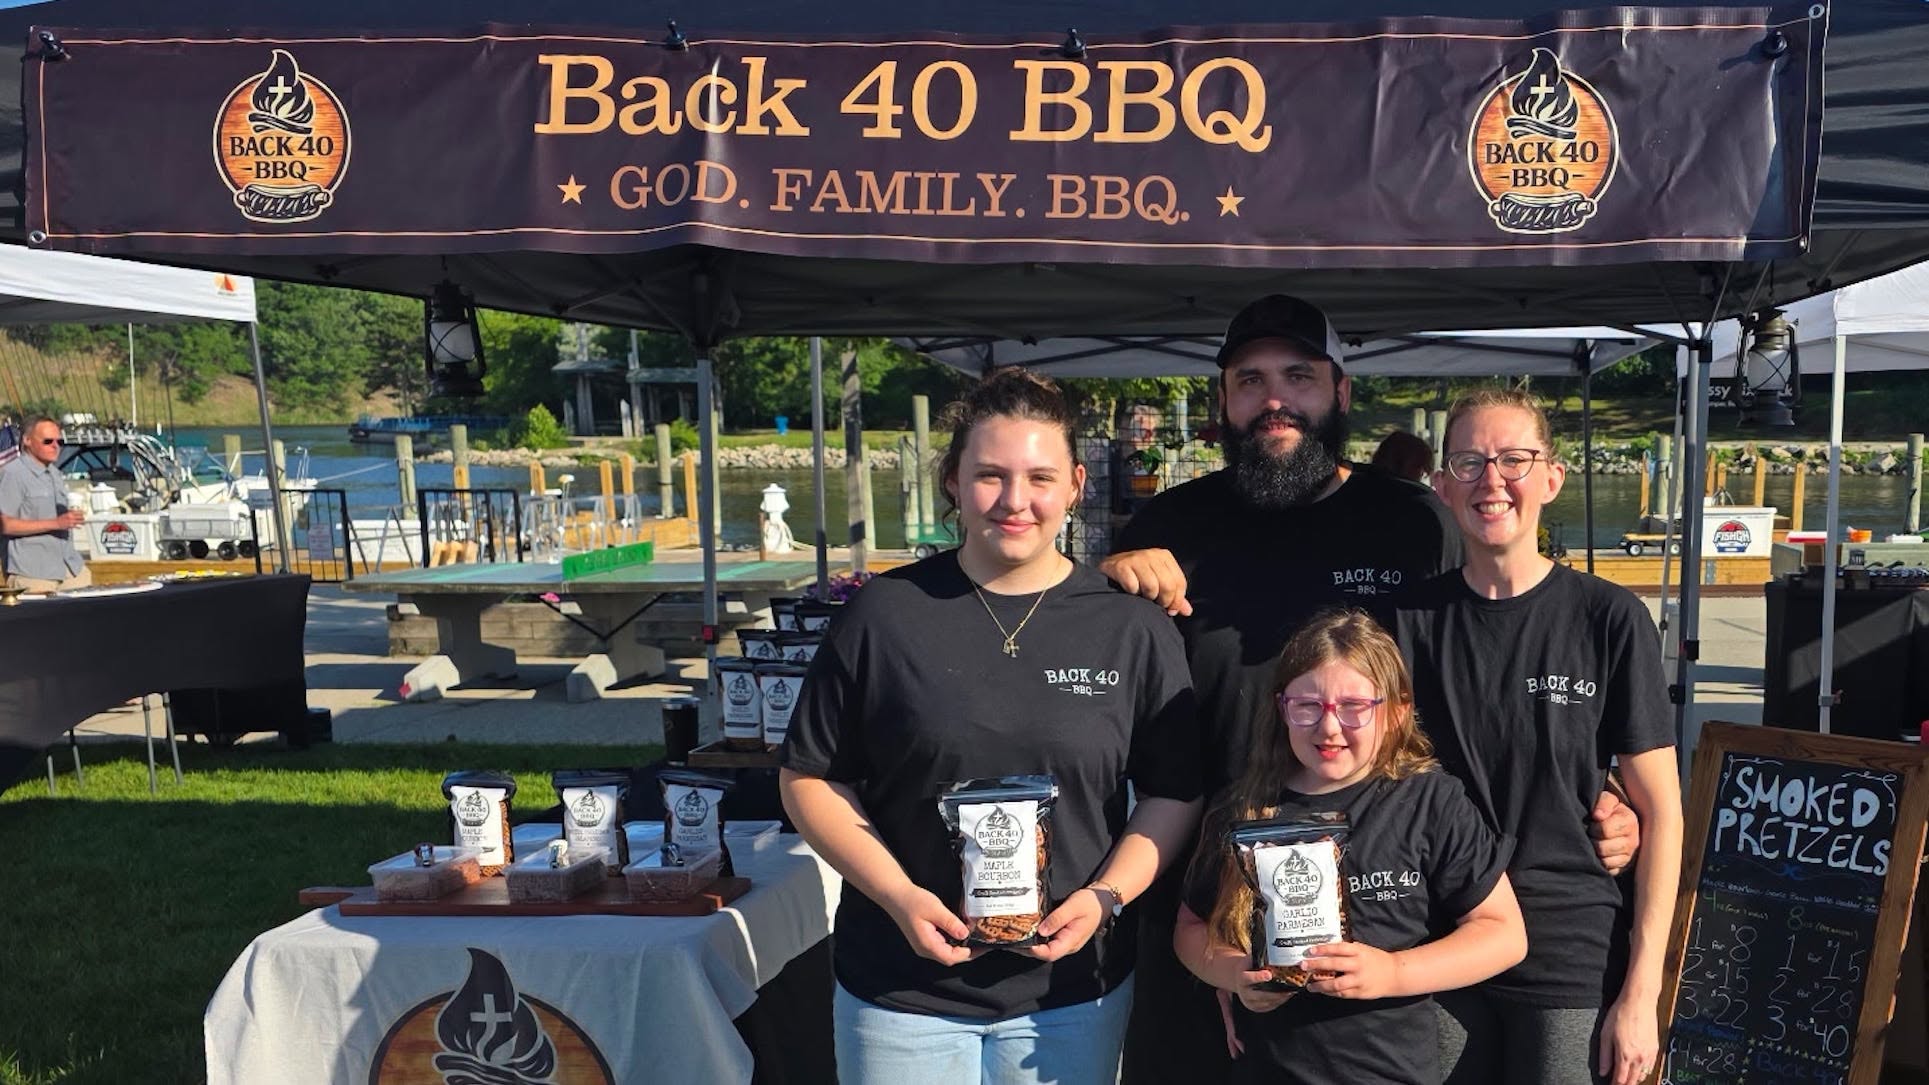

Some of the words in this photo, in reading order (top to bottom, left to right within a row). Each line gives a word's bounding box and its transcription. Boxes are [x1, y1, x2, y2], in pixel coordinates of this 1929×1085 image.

[534, 53, 810, 137] Back
[840, 60, 979, 140] 40
[1009, 56, 1272, 153] BBQ
[229, 136, 294, 158] BACK
[297, 135, 334, 157] 40
[1485, 141, 1557, 165] BACK
[1559, 139, 1600, 164] 40
[255, 160, 308, 182] BBQ
[1512, 167, 1572, 190] BBQ
[610, 160, 750, 210] GOD.
[770, 168, 1026, 219] FAMILY.
[1045, 173, 1191, 225] BBQ.
[1332, 568, 1375, 585] BACK
[1380, 569, 1402, 585] 40
[1357, 585, 1376, 595] BBQ
[1044, 668, 1091, 684] BACK
[1095, 669, 1120, 686] 40
[1526, 675, 1570, 693] BACK
[1573, 679, 1597, 697] 40
[1072, 685, 1093, 696] BBQ
[1550, 692, 1569, 705] BBQ
[1732, 766, 1880, 828] SMOKED
[978, 831, 1004, 839] BACK
[988, 838, 1010, 846] BBQ
[1714, 808, 1892, 877] PRETZELS
[978, 870, 1021, 881] BOURBON
[983, 860, 1015, 870] MAPLE
[1276, 877, 1302, 889] BACK
[1304, 875, 1318, 883] 40
[1348, 870, 1395, 893] BACK
[1399, 870, 1420, 886] 40
[1376, 890, 1397, 901] BBQ
[1277, 918, 1326, 931] PARMESAN
[1689, 917, 1706, 951] 1
[1779, 934, 1796, 972] 1
[1681, 952, 1704, 985] 2
[1769, 974, 1792, 1005] 2
[1678, 986, 1699, 1019] 3
[1761, 1005, 1786, 1041] 3
